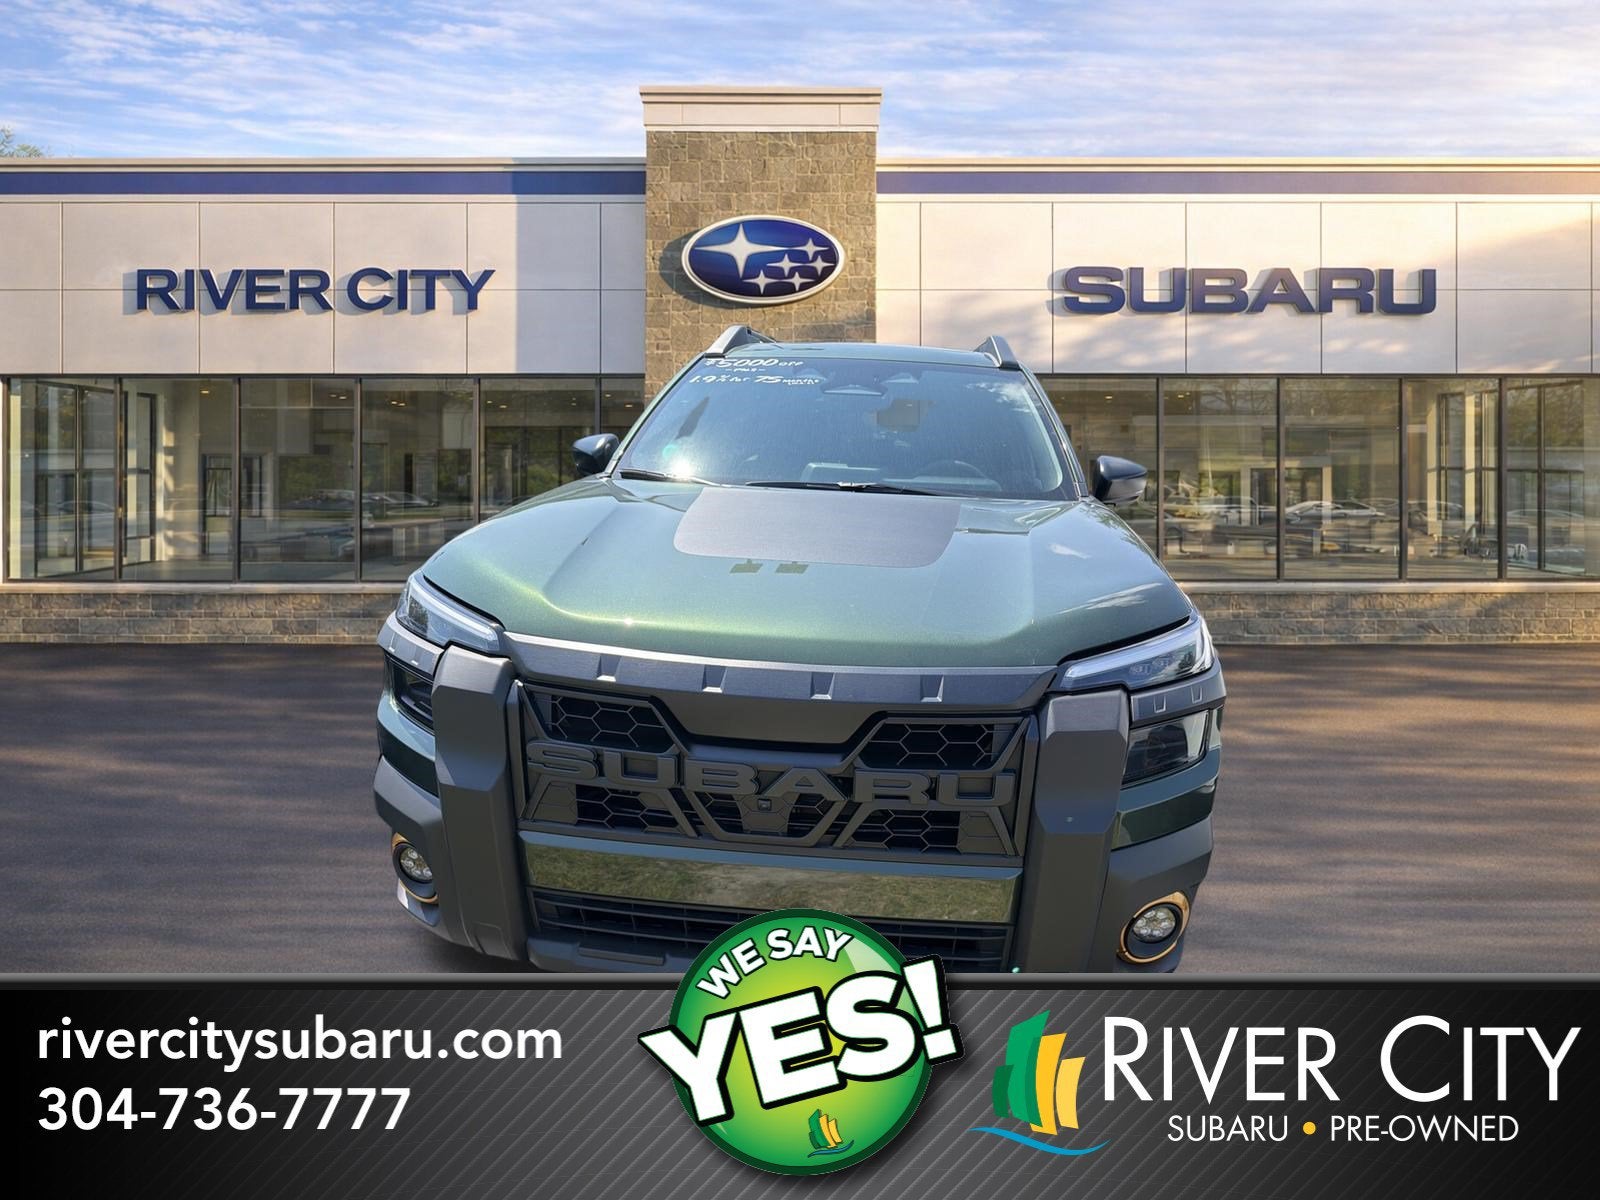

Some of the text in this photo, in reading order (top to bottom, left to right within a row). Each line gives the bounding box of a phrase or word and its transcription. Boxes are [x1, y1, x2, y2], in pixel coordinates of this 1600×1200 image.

[136, 267, 496, 311] RIVER CITY
[1063, 266, 1437, 315] SUBARU
[527, 741, 1017, 808] SUBARU
